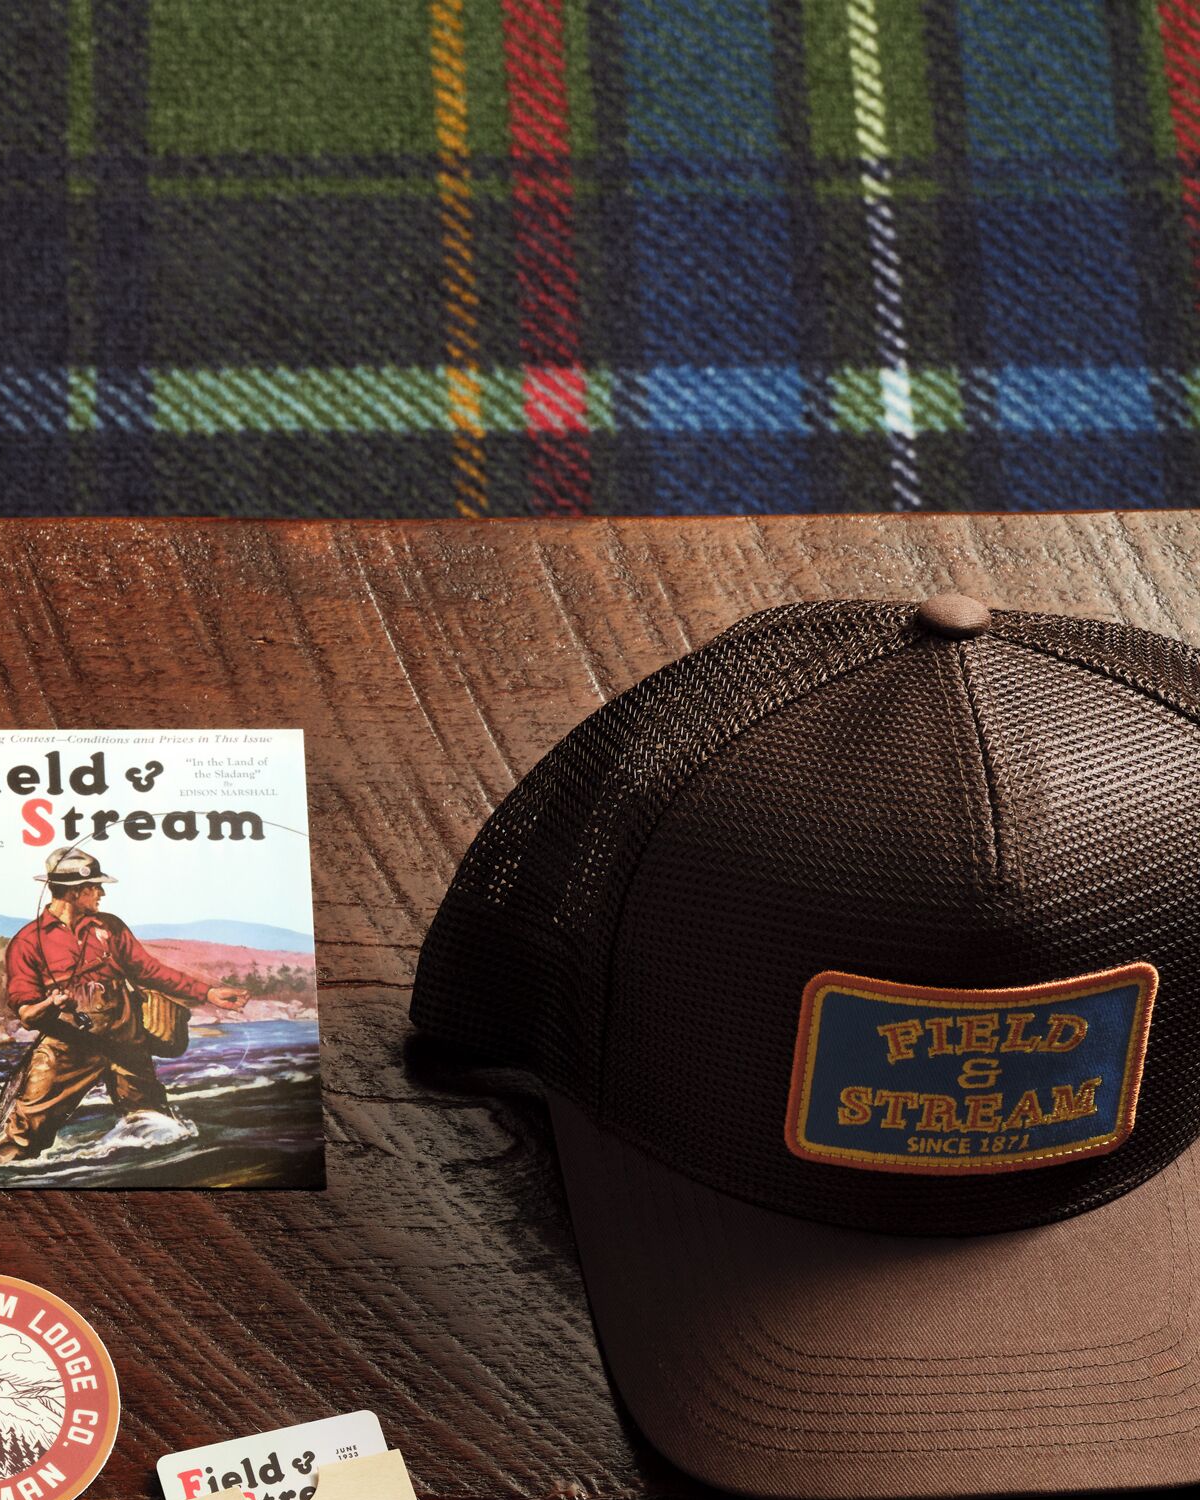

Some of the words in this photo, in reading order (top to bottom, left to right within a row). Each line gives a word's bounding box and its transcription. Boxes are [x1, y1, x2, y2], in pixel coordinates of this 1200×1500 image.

[133, 735, 154, 744] and
[159, 735, 194, 744] Prizes
[198, 734, 209, 744] in
[214, 734, 239, 744] This
[243, 734, 273, 744] Issue
[125, 760, 164, 793] &
[194, 769, 212, 779] the
[207, 757, 224, 767] the
[227, 757, 255, 767] Land
[257, 757, 269, 767] of
[180, 788, 218, 797] EDISON
[221, 788, 278, 797] MARSHALL
[21, 798, 266, 848] Stream
[877, 1013, 1089, 1065] FIELD
[957, 1058, 1003, 1089] &
[838, 1076, 1102, 1132] STREAM
[906, 1136, 971, 1154] SINCE
[980, 1134, 1031, 1152] 1871
[27, 1309, 98, 1394] LODGE
[62, 1408, 99, 1448] CO.
[335, 1444, 358, 1455] JUNE
[338, 1451, 360, 1461] 1933
[176, 1451, 286, 1500] Field
[291, 1450, 316, 1475] &
